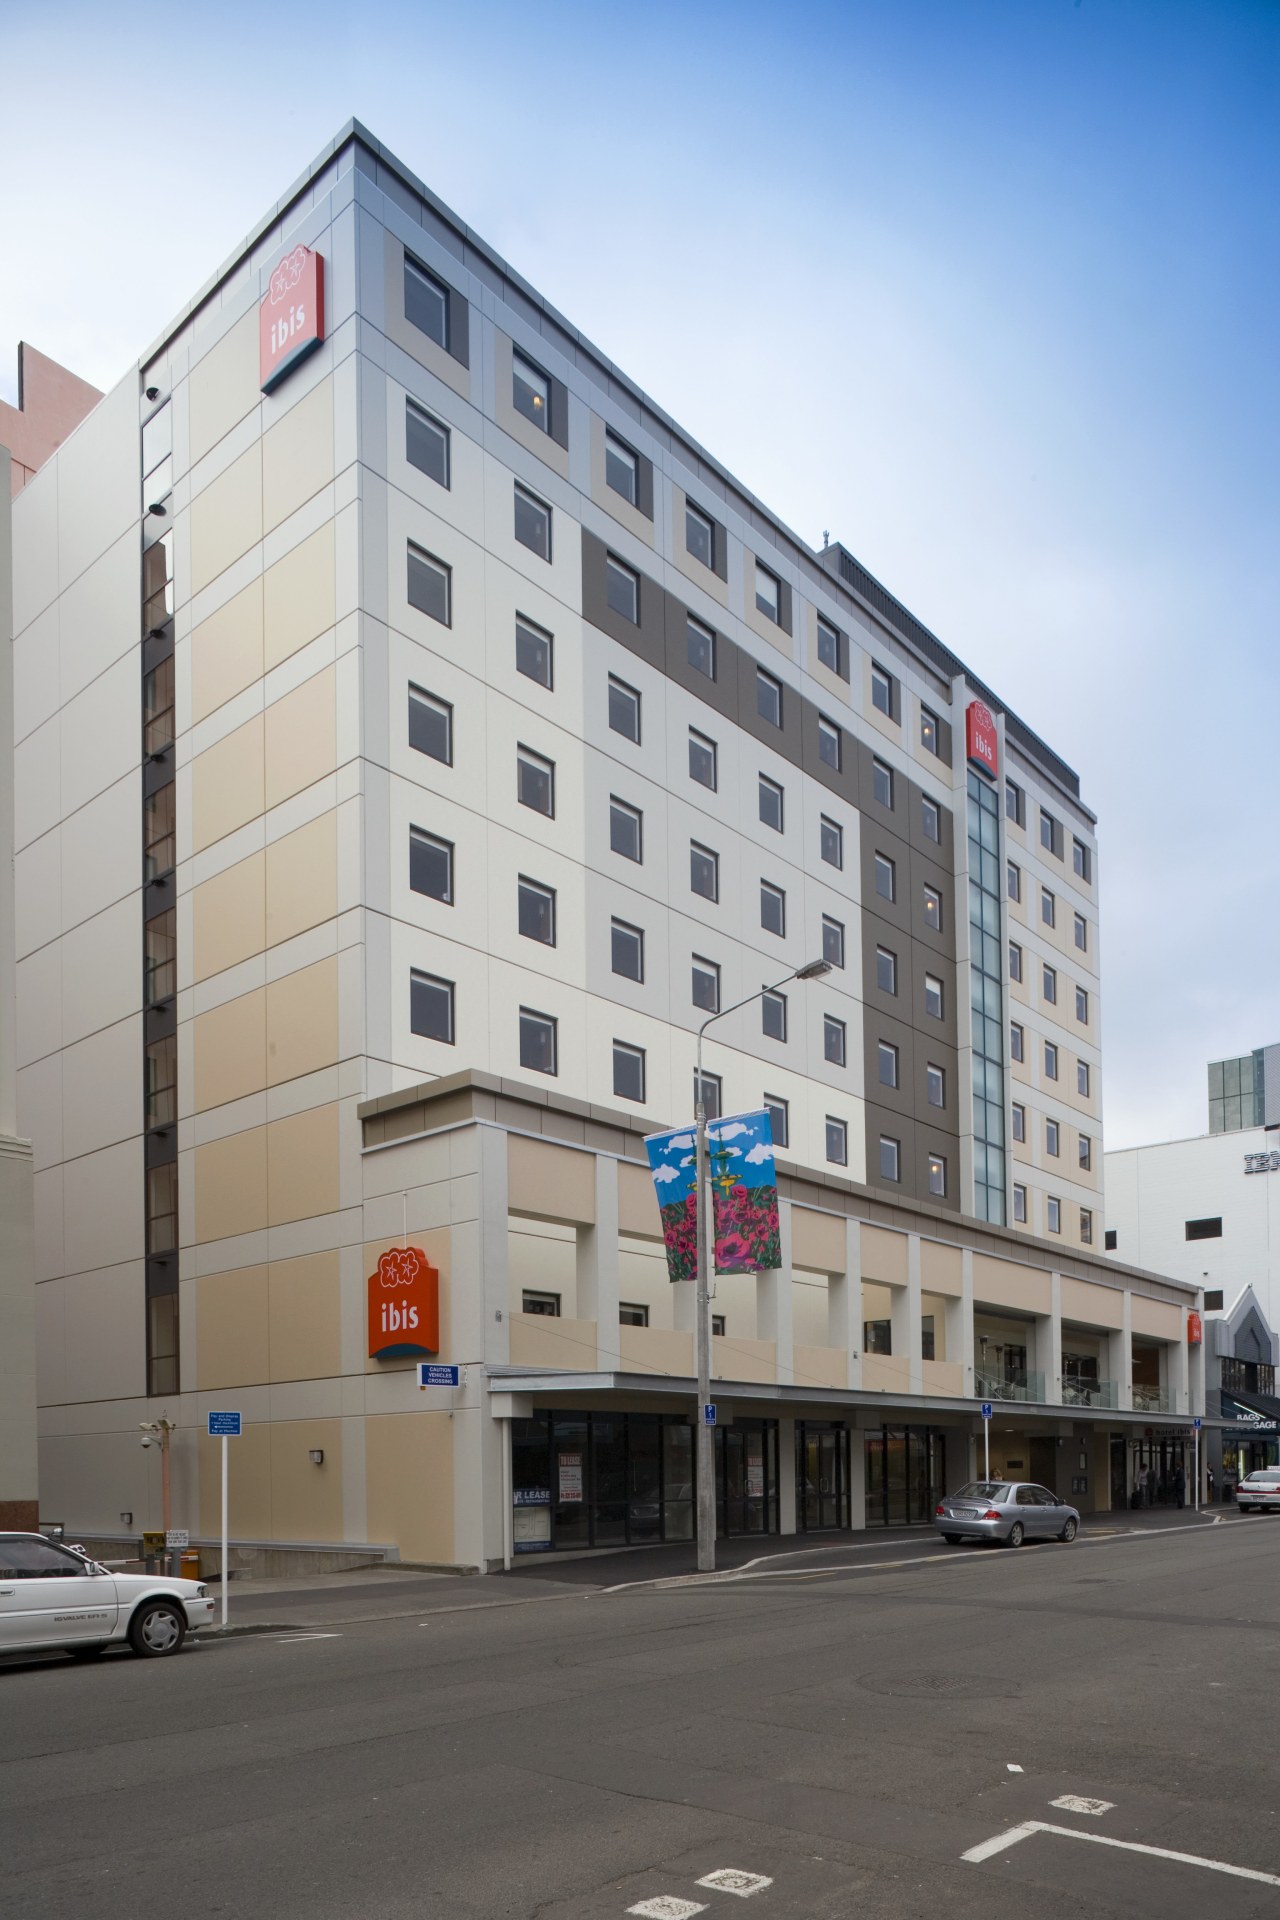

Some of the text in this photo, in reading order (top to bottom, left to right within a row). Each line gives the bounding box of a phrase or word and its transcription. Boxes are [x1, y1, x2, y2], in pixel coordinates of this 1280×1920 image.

[271, 304, 306, 354] ibis
[975, 732, 993, 761] ibis
[381, 1300, 419, 1333] ibis
[1156, 1428, 1175, 1436] hotel
[524, 1490, 551, 1499] LEASE
